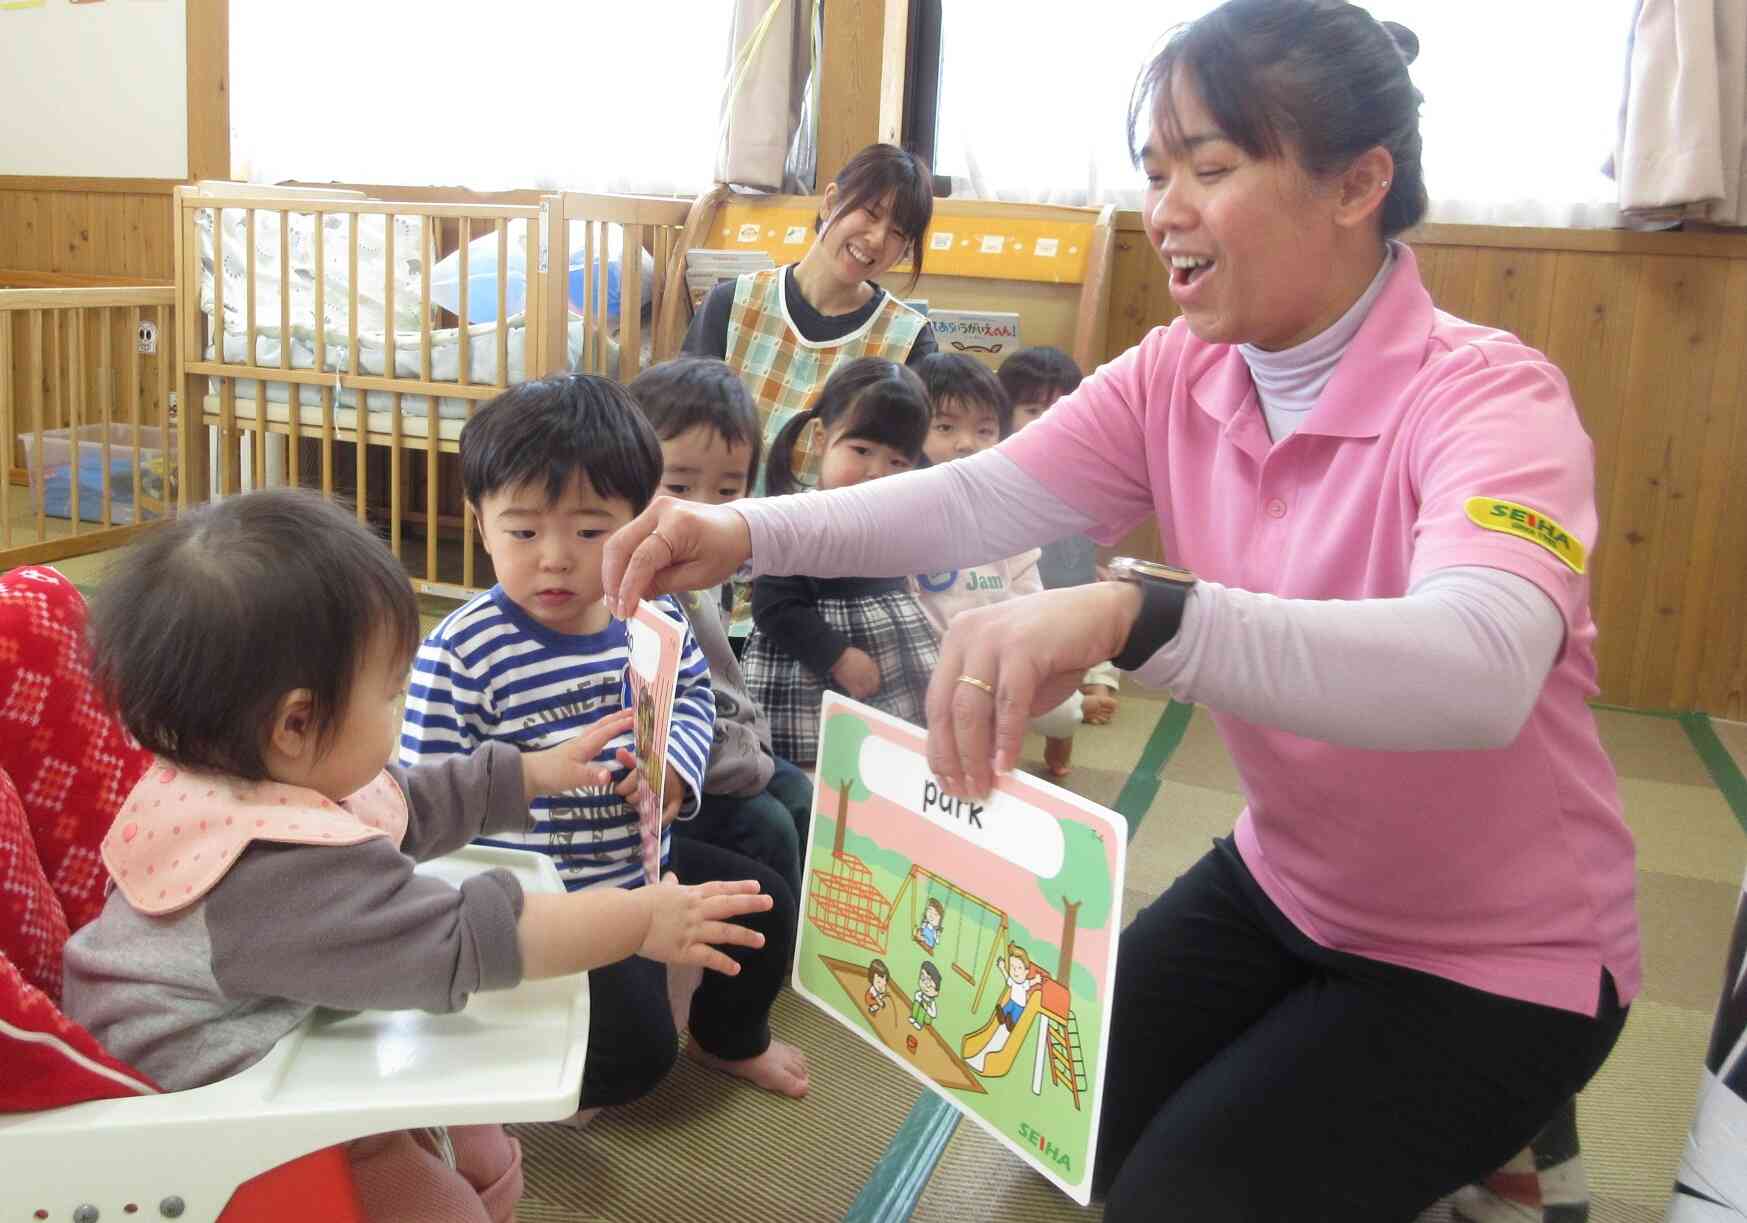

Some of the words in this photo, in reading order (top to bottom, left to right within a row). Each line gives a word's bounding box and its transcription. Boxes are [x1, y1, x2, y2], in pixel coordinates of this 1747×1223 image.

[1490, 505, 1571, 550] SEIHA
[966, 571, 1003, 591] Jam
[1018, 1122, 1071, 1172] SEIHA
